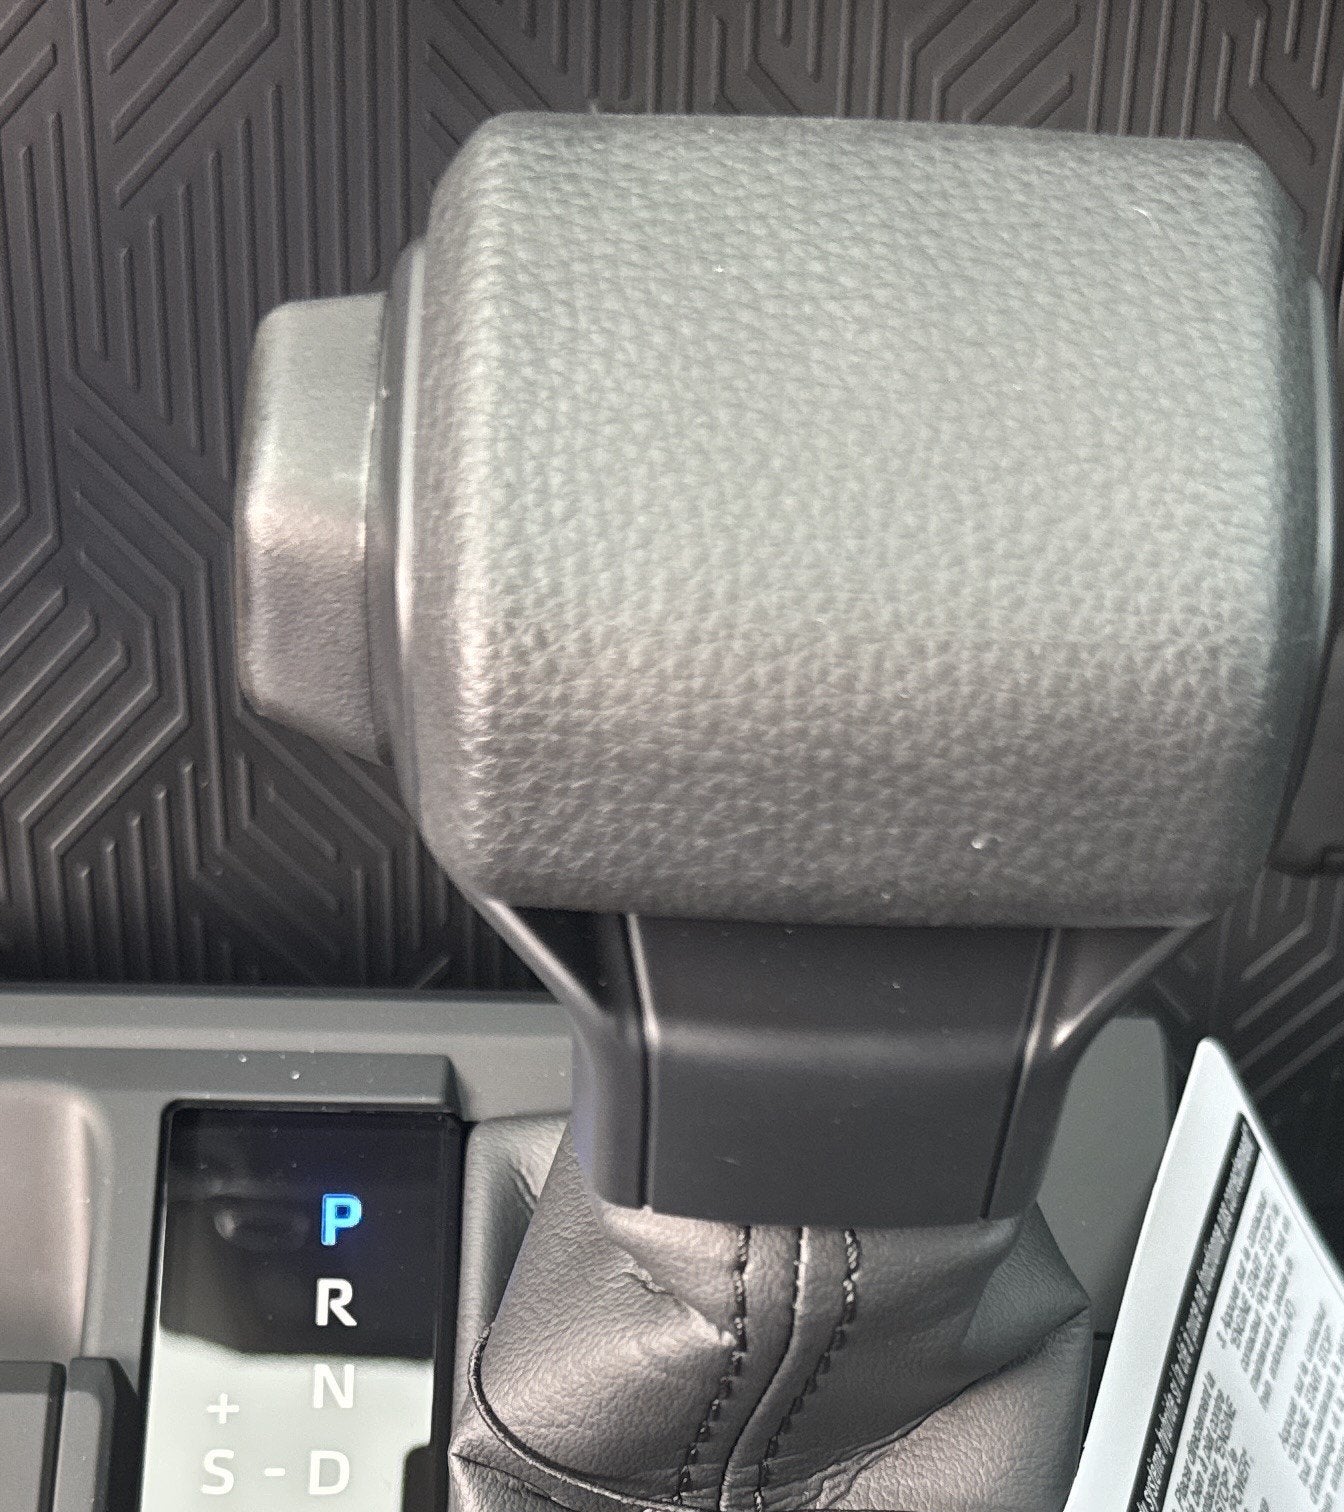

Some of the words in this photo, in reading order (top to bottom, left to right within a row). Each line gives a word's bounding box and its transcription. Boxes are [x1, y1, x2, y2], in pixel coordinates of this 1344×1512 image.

[320, 1193, 362, 1246] P
[316, 1277, 358, 1327] R
[312, 1363, 354, 1410] N
[1143, 1443, 1166, 1511] système
[1155, 1393, 1178, 1453] hybride
[1174, 1458, 1192, 1511] Placer
[1186, 1382, 1211, 1465] directement
[1204, 1370, 1216, 1390] la
[201, 1449, 235, 1497] S
[307, 1450, 350, 1496] D
[1189, 1470, 1205, 1507] bien
